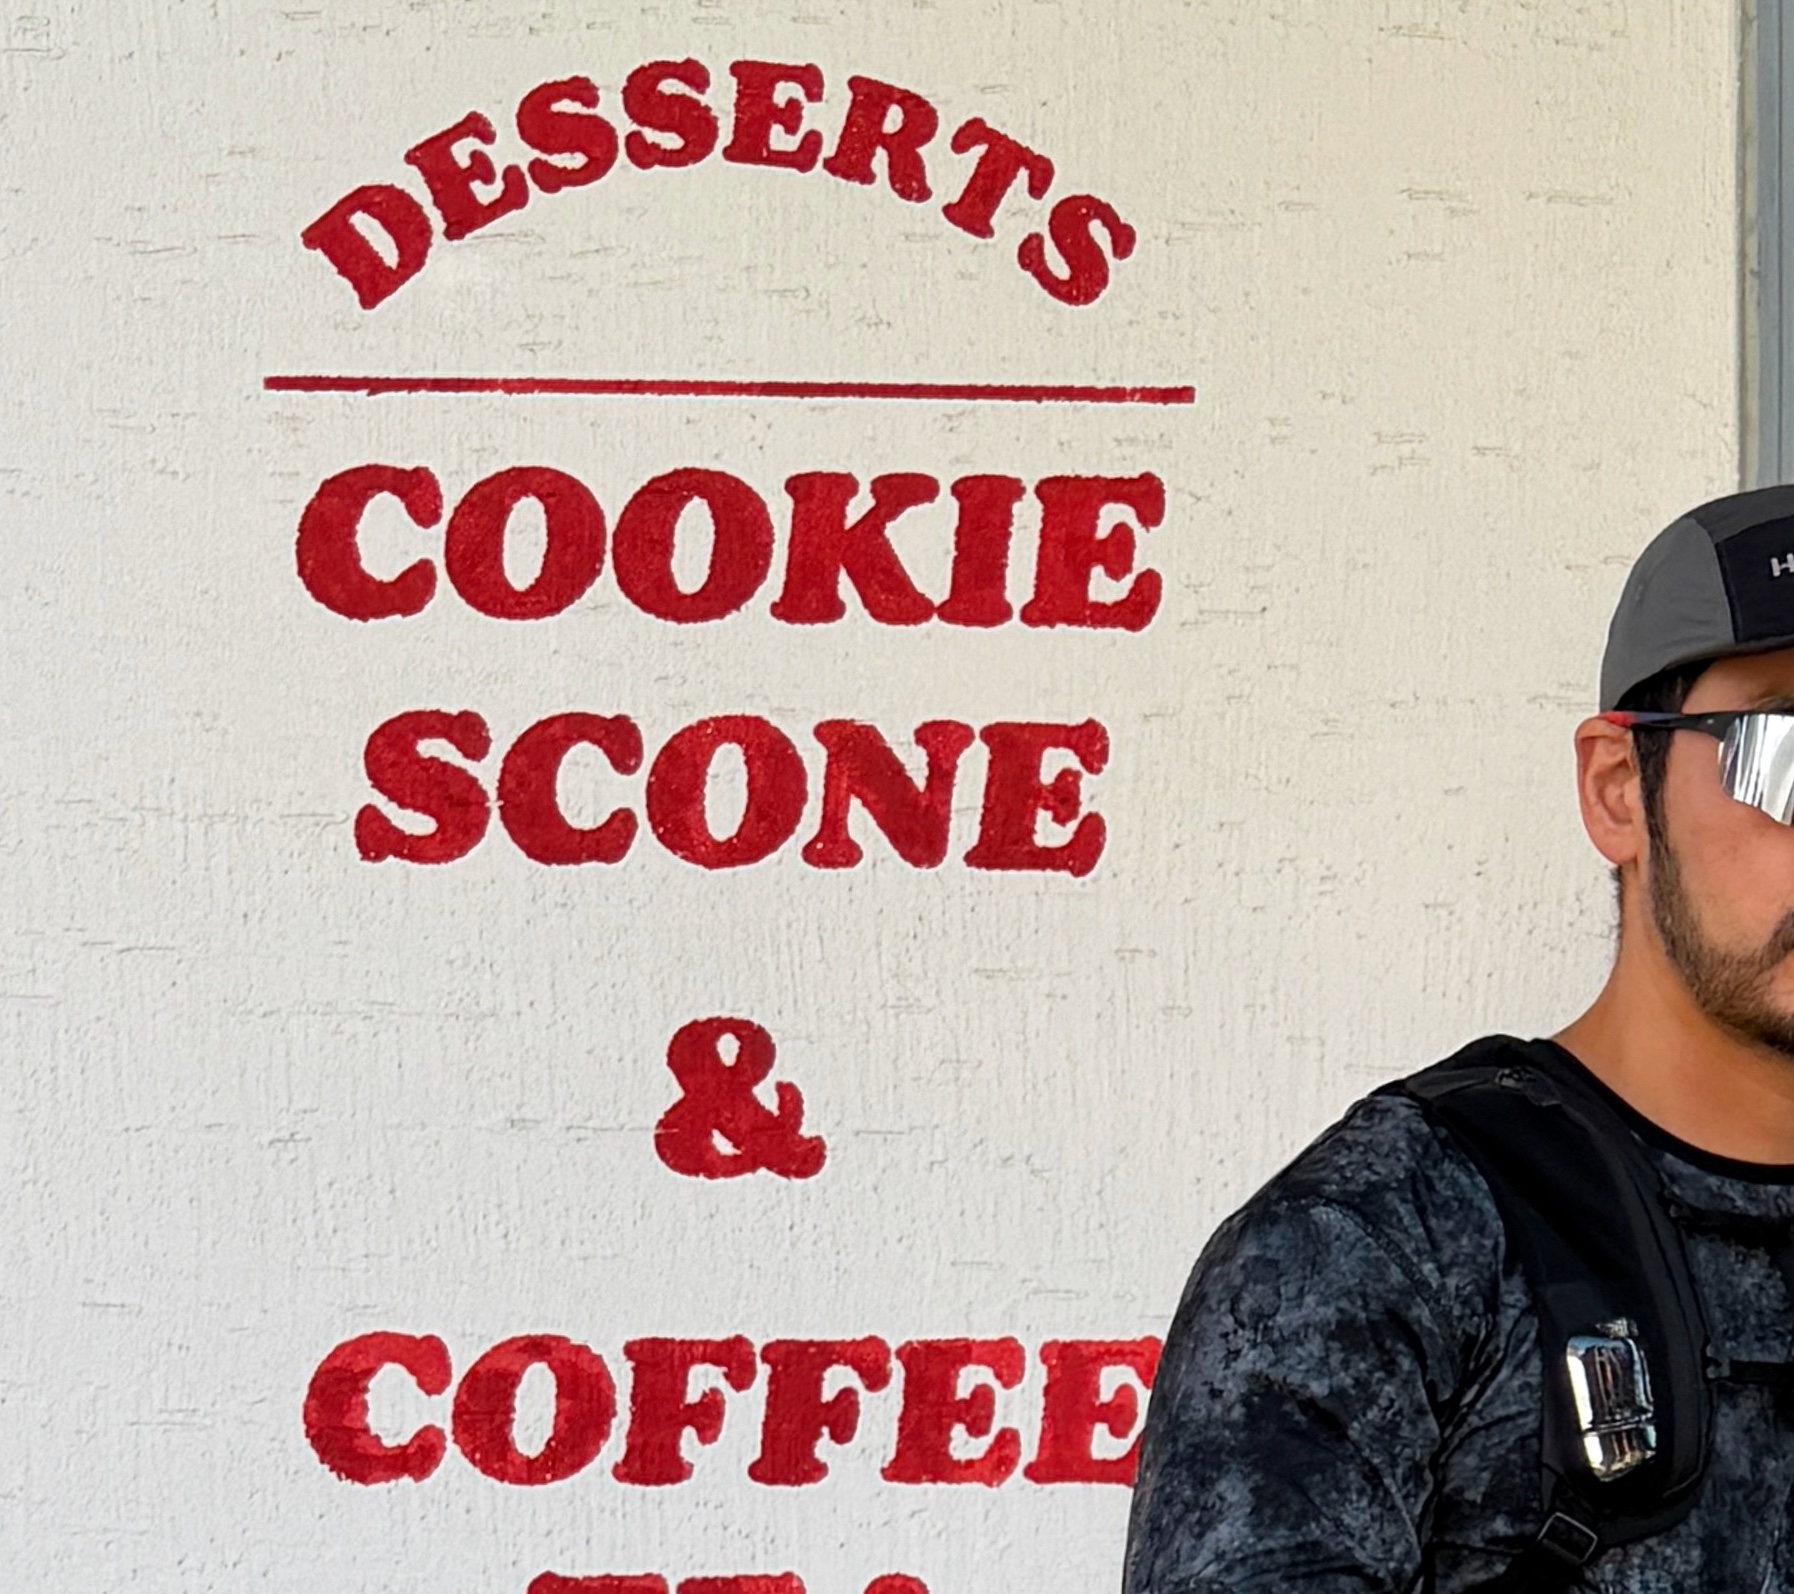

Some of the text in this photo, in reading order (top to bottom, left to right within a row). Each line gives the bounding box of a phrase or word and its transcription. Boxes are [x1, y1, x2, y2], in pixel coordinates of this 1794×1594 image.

[302, 59, 1135, 309] DESSERTS
[296, 464, 1165, 632] COOKIE
[354, 710, 1108, 877] SCONE
[653, 1016, 827, 1180] &
[303, 1331, 1162, 1486] COFFEE
